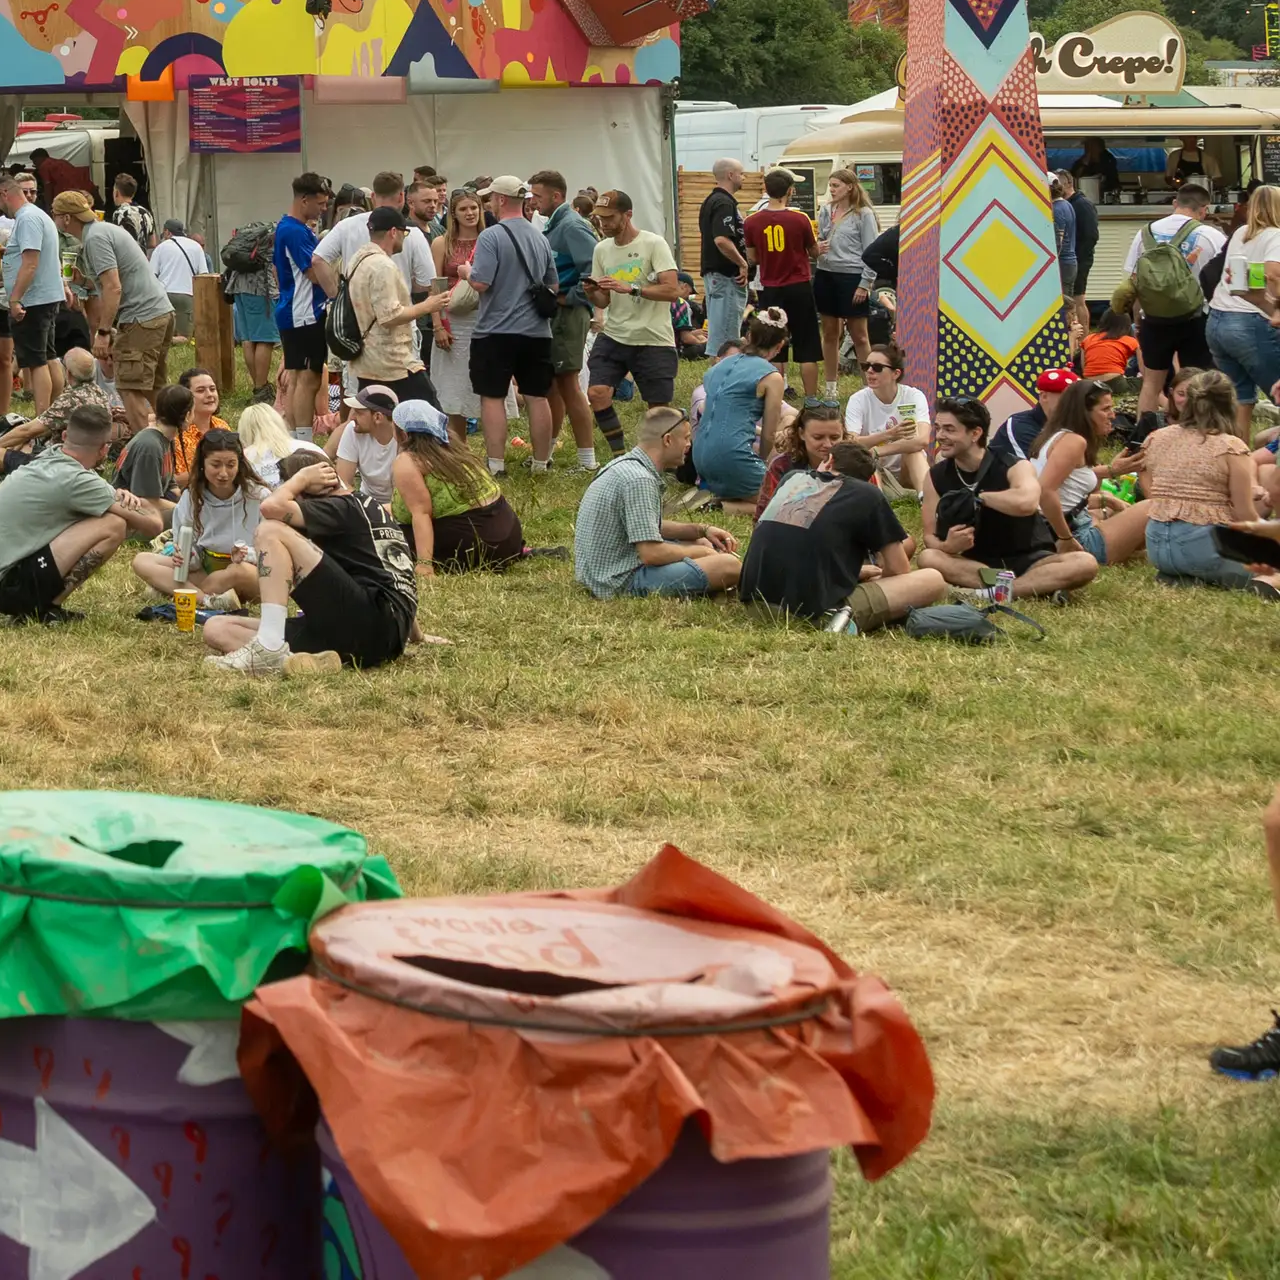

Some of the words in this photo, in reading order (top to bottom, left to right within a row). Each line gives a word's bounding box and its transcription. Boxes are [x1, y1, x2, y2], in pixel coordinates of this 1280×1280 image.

[1058, 36, 1179, 84] Crepe!
[209, 77, 239, 87] WEST
[243, 77, 279, 87] HOLTS
[763, 224, 785, 252] 10
